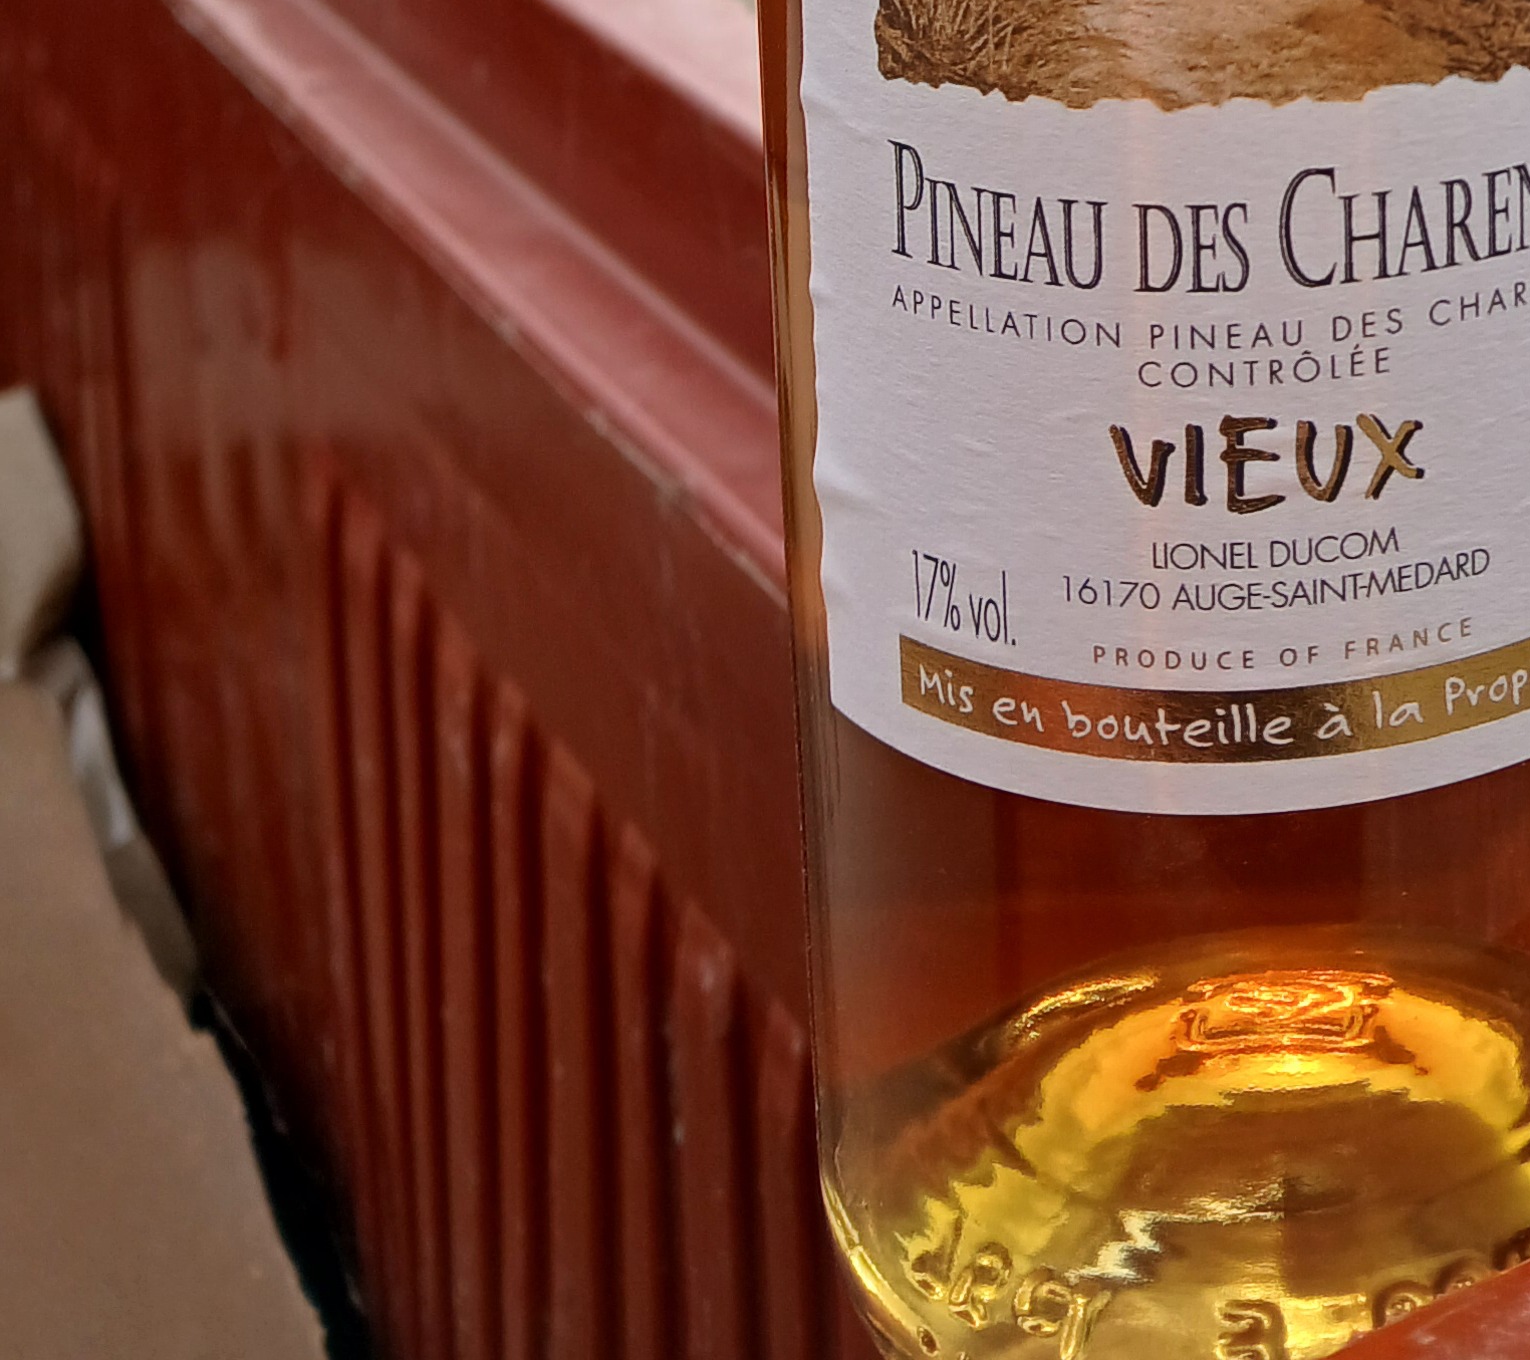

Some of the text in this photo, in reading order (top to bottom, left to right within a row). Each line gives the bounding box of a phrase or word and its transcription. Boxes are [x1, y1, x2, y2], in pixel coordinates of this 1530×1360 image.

[887, 139, 1109, 290] PINEAU
[1132, 202, 1250, 293] DES
[892, 285, 1122, 348] APPELLATION
[1149, 320, 1305, 350] PINEAU
[1331, 307, 1405, 341] DES
[1138, 343, 1391, 388] CONTRÔLÉE
[1109, 414, 1425, 514] VIEUX
[1062, 547, 1490, 612] 16170 AUGE-SAINT-MEDARD
[1151, 527, 1400, 571] LIONEL DUCOM
[911, 548, 1016, 646] 17% vol.
[1093, 616, 1475, 671] PRODUCE OF FRANCE
[916, 664, 974, 715] Mis
[993, 694, 1045, 733] en
[1061, 700, 1294, 747] bouteille
[1317, 705, 1351, 739] à
[1372, 690, 1422, 730] la
